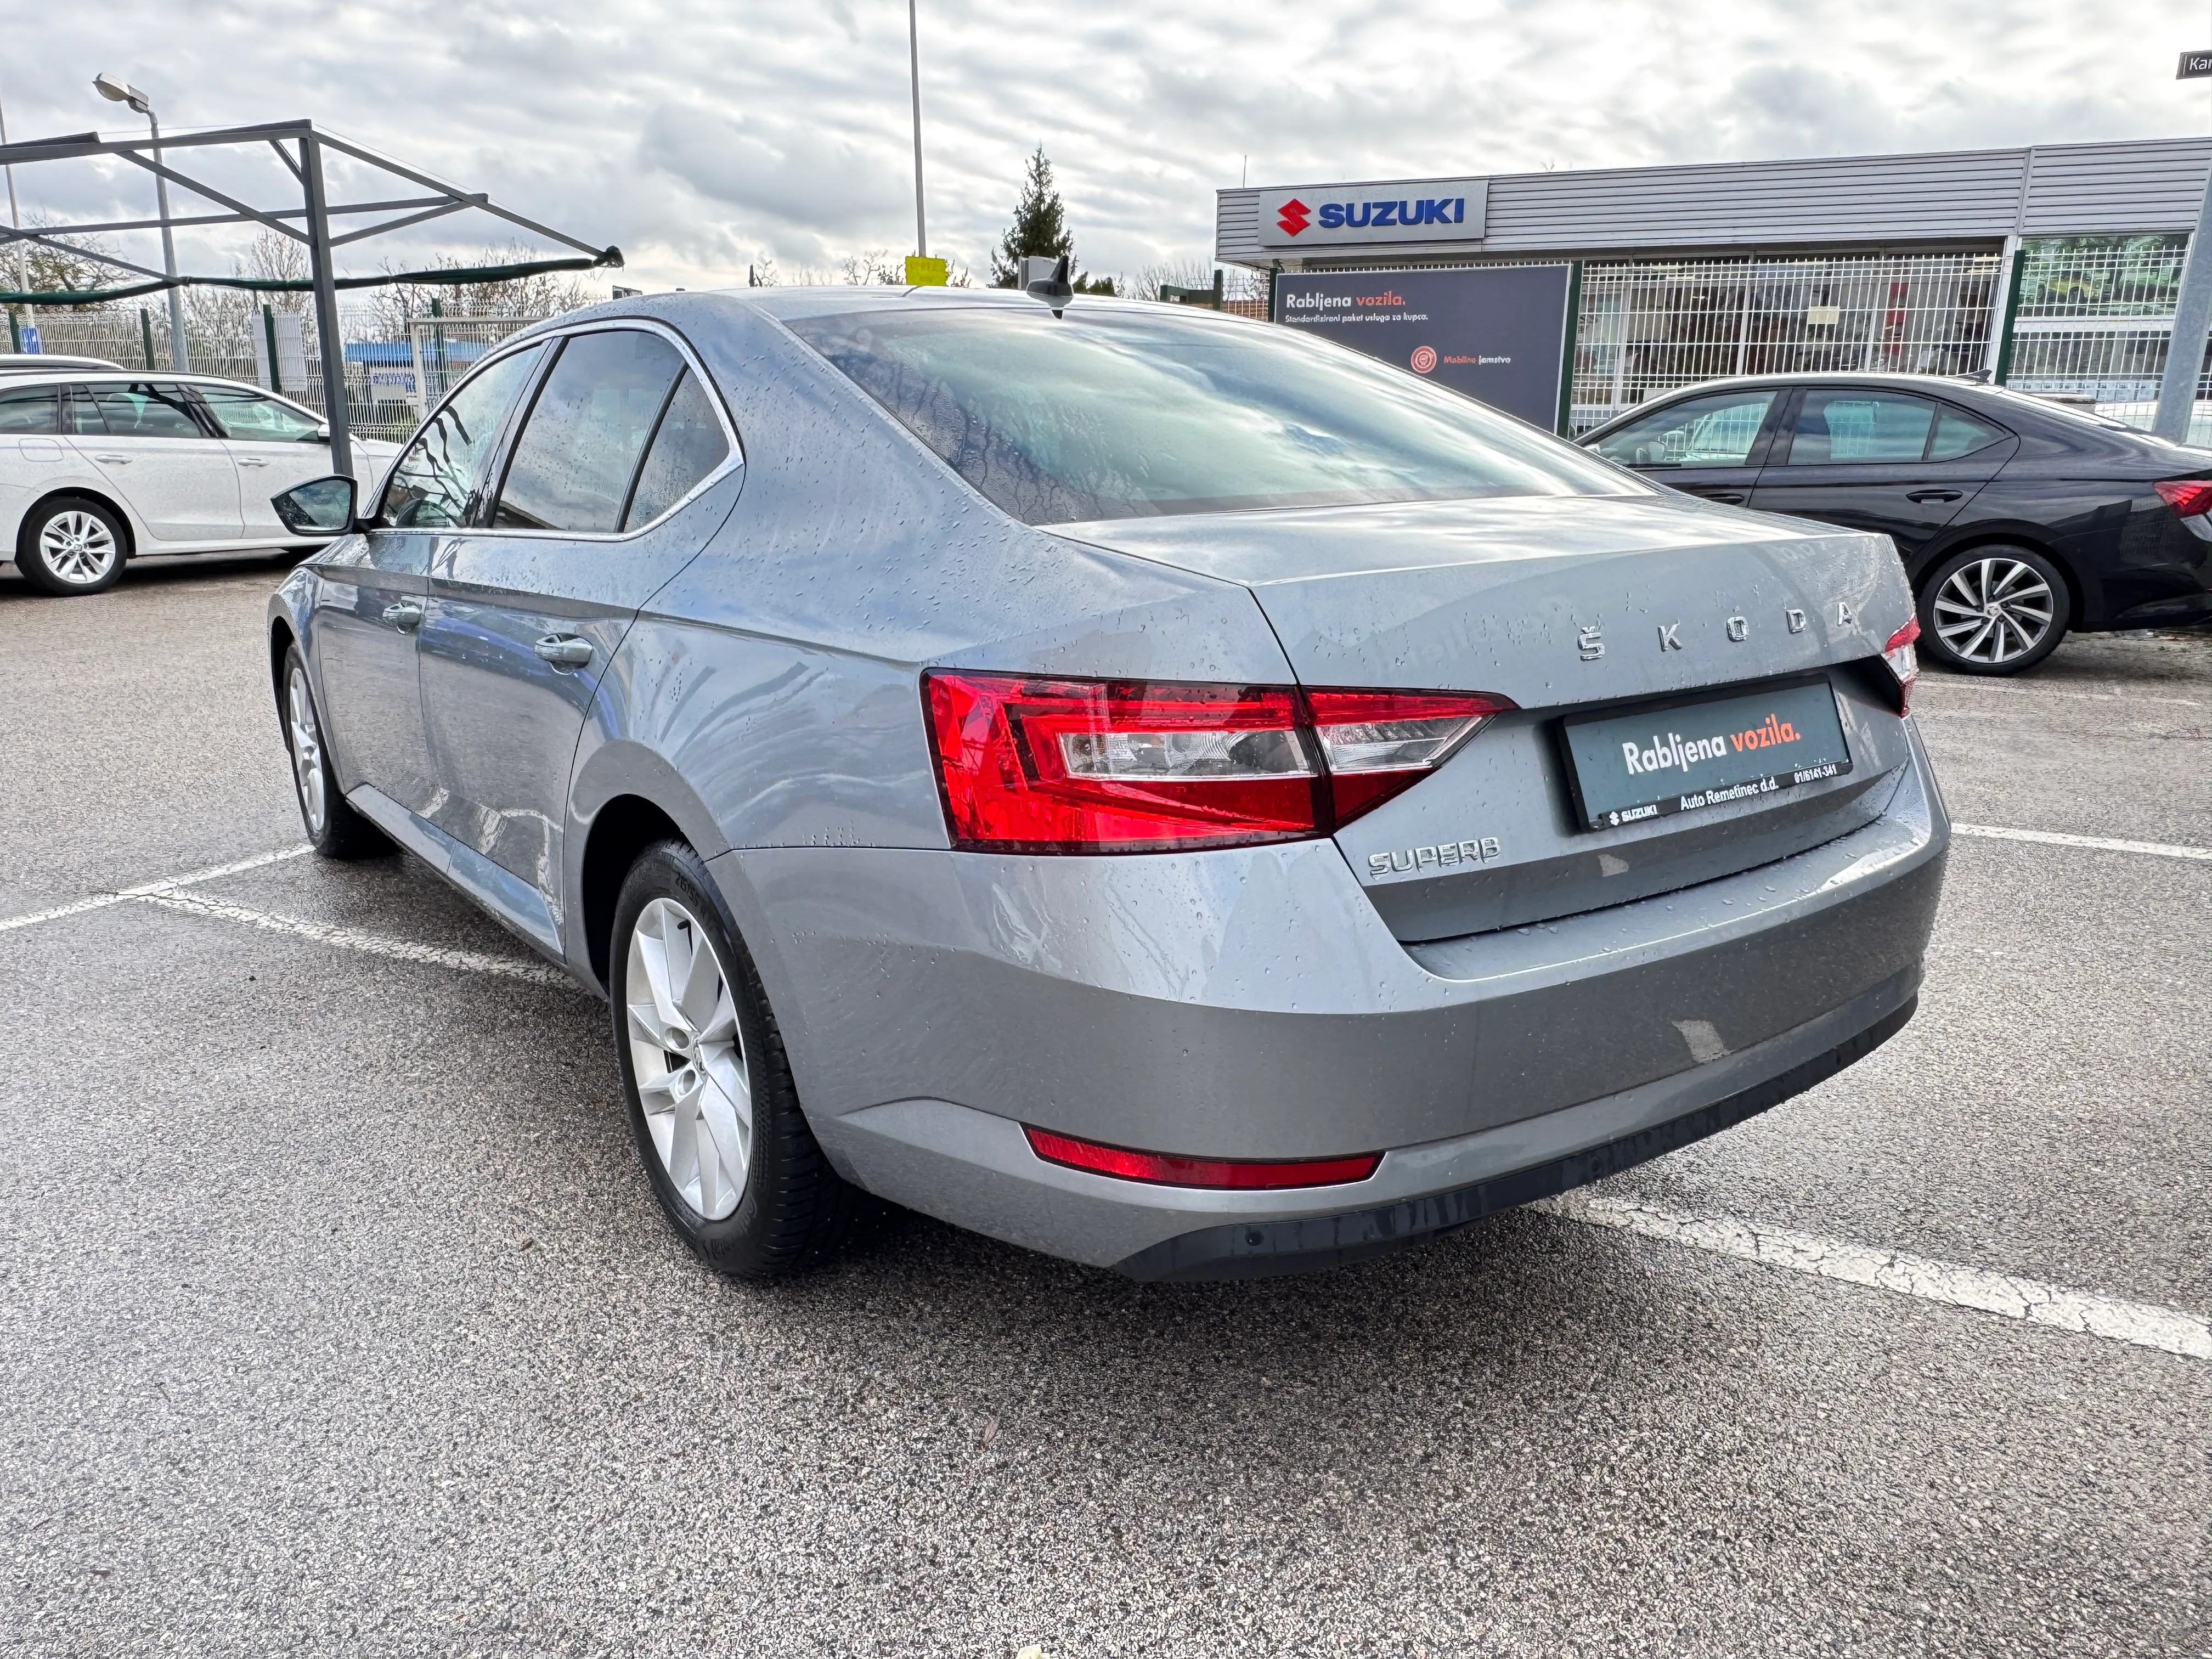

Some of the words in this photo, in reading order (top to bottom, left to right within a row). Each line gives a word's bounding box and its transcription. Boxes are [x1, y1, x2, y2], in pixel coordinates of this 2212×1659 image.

[1318, 198, 1465, 228] SUZUKI
[1286, 292, 1352, 311] Rabljena
[1356, 291, 1406, 306] vozila.
[1342, 313, 1363, 323] paket
[1578, 602, 1853, 661] ŠKODA
[1622, 732, 1727, 775] Rabljena
[1730, 714, 1801, 752] vozila.
[1680, 794, 1705, 811] Auto
[1706, 782, 1759, 805] Remetinec
[1760, 776, 1779, 792] d.d.
[1621, 804, 1658, 822] SUZUKI
[1368, 837, 1501, 879] SUPERB
